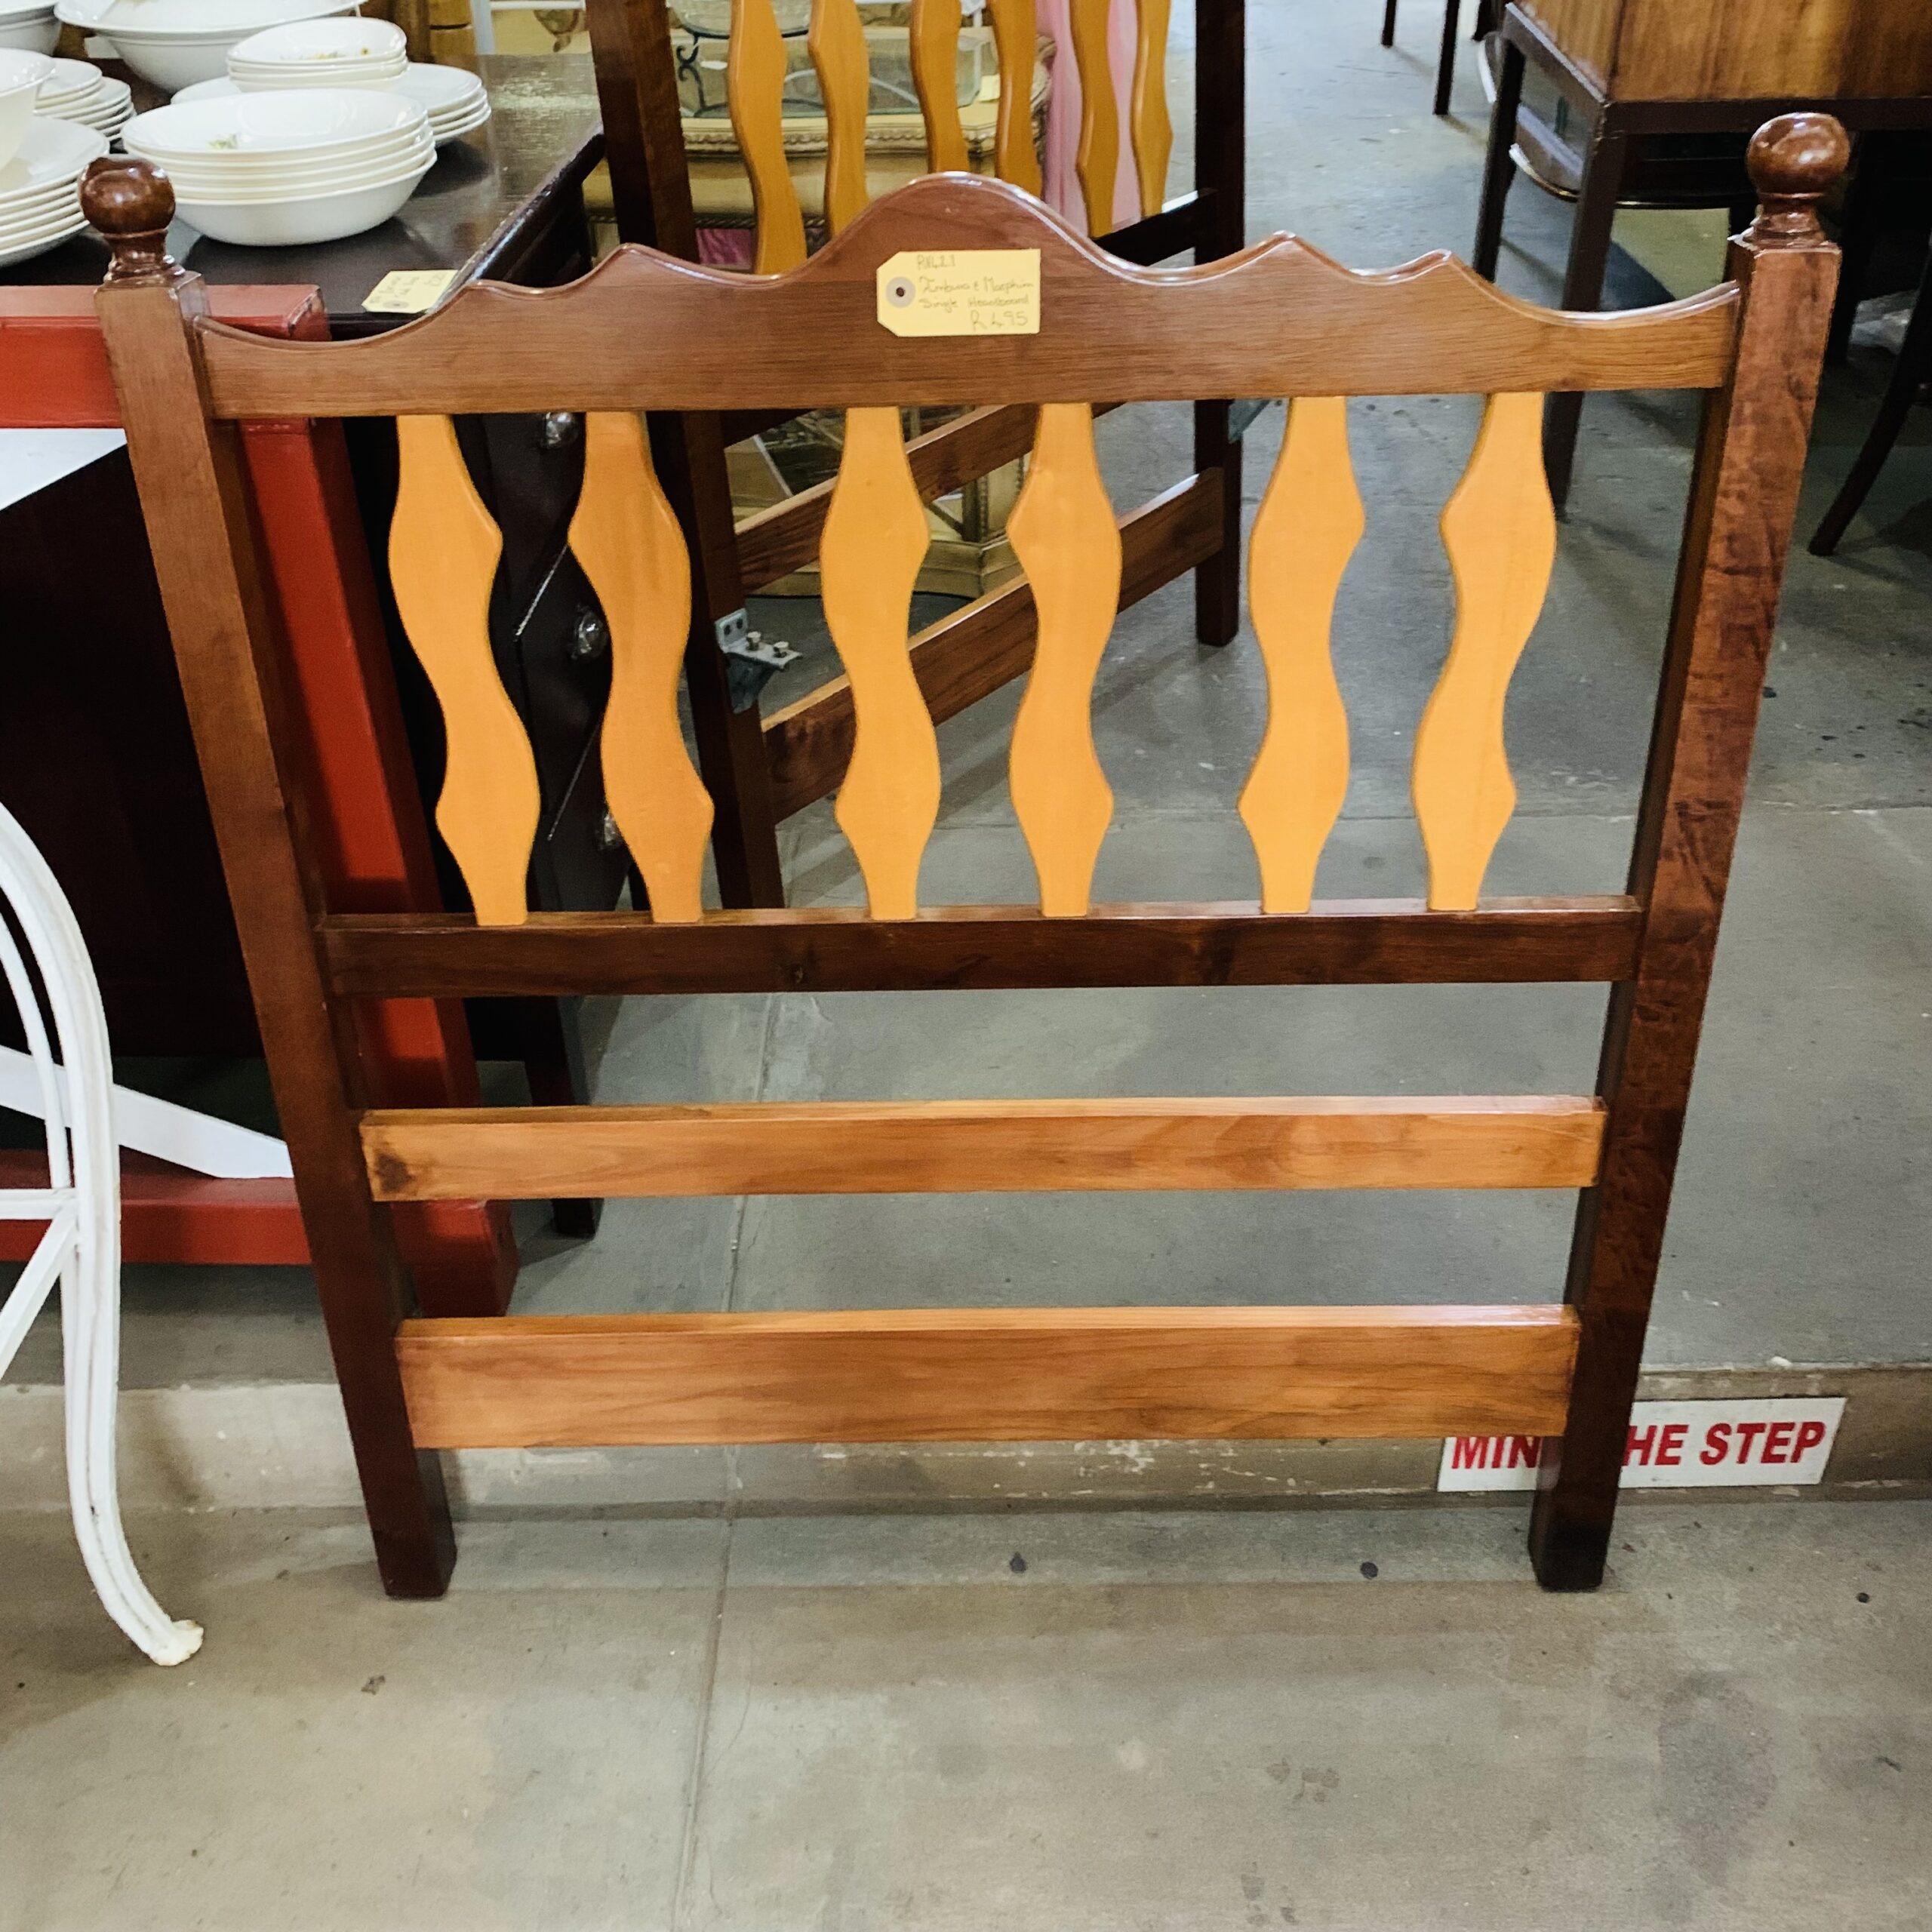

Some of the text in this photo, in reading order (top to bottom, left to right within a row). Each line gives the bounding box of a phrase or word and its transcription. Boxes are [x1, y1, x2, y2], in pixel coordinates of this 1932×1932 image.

[1451, 1422, 1826, 1469] MIN HE STEP
